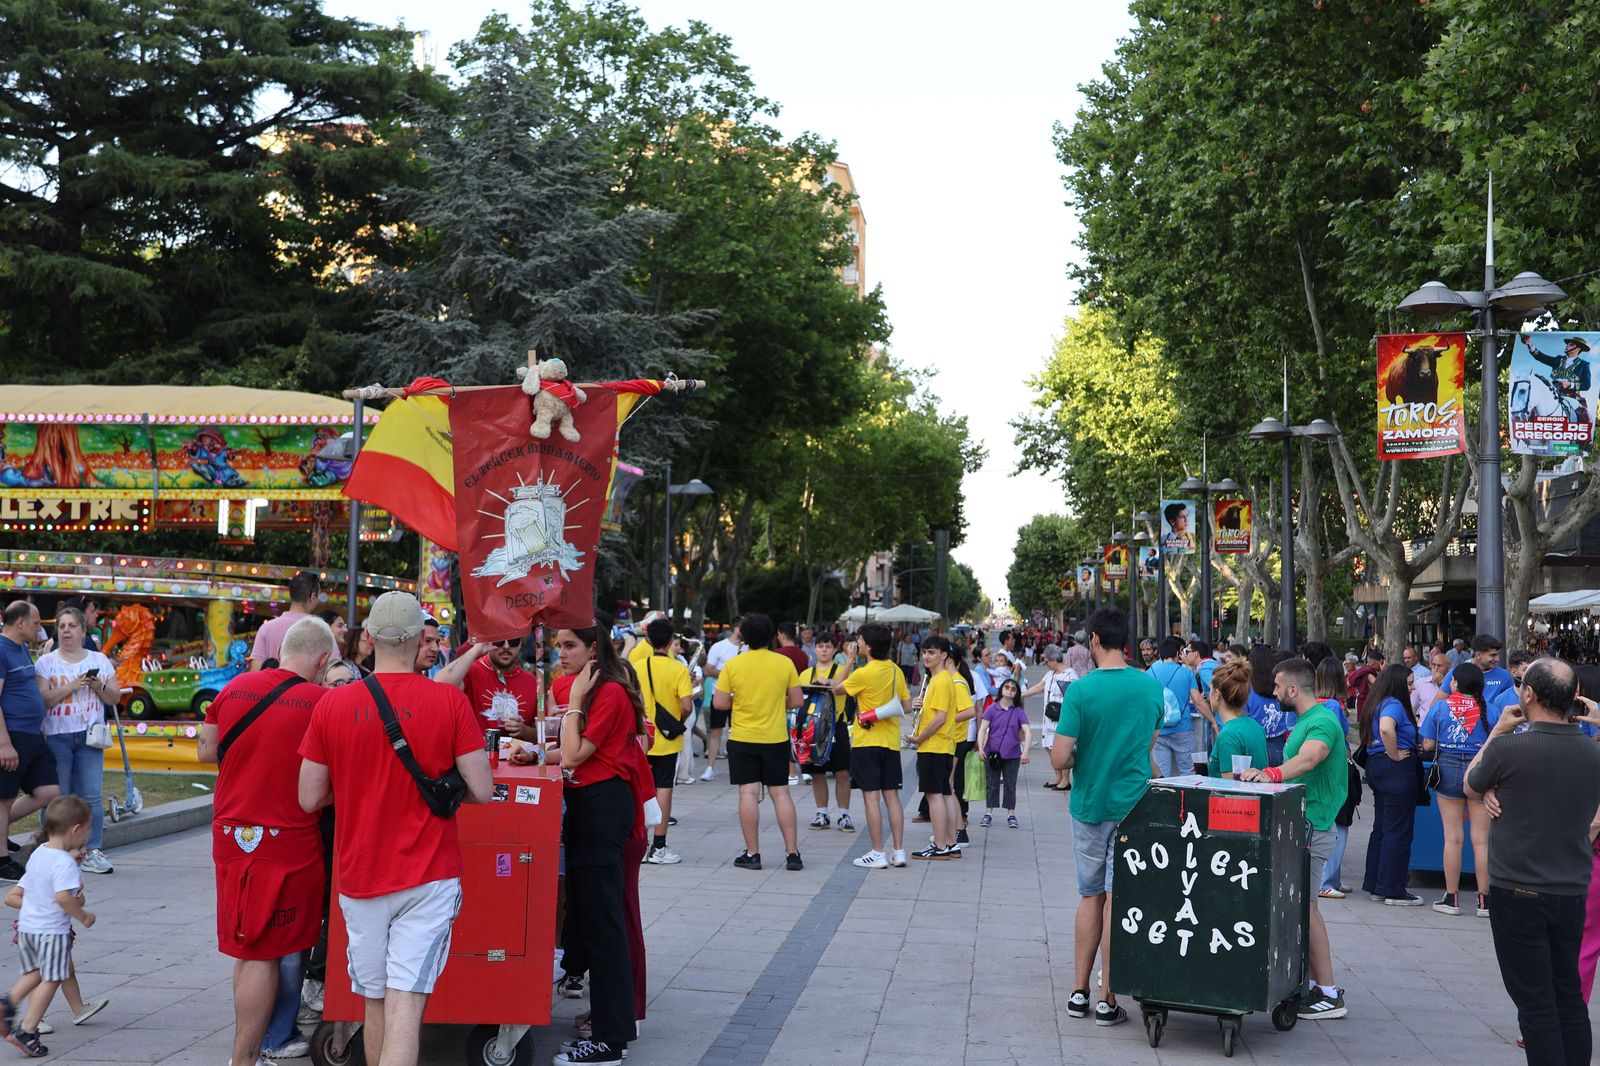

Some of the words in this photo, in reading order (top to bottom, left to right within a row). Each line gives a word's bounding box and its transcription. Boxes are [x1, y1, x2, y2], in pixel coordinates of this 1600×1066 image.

[1380, 398, 1456, 428] TOROS
[1382, 427, 1459, 440] ZAMORA
[1567, 423, 1589, 432] DE
[1515, 430, 1589, 440] GREGORIO
[504, 592, 545, 609] DESDE
